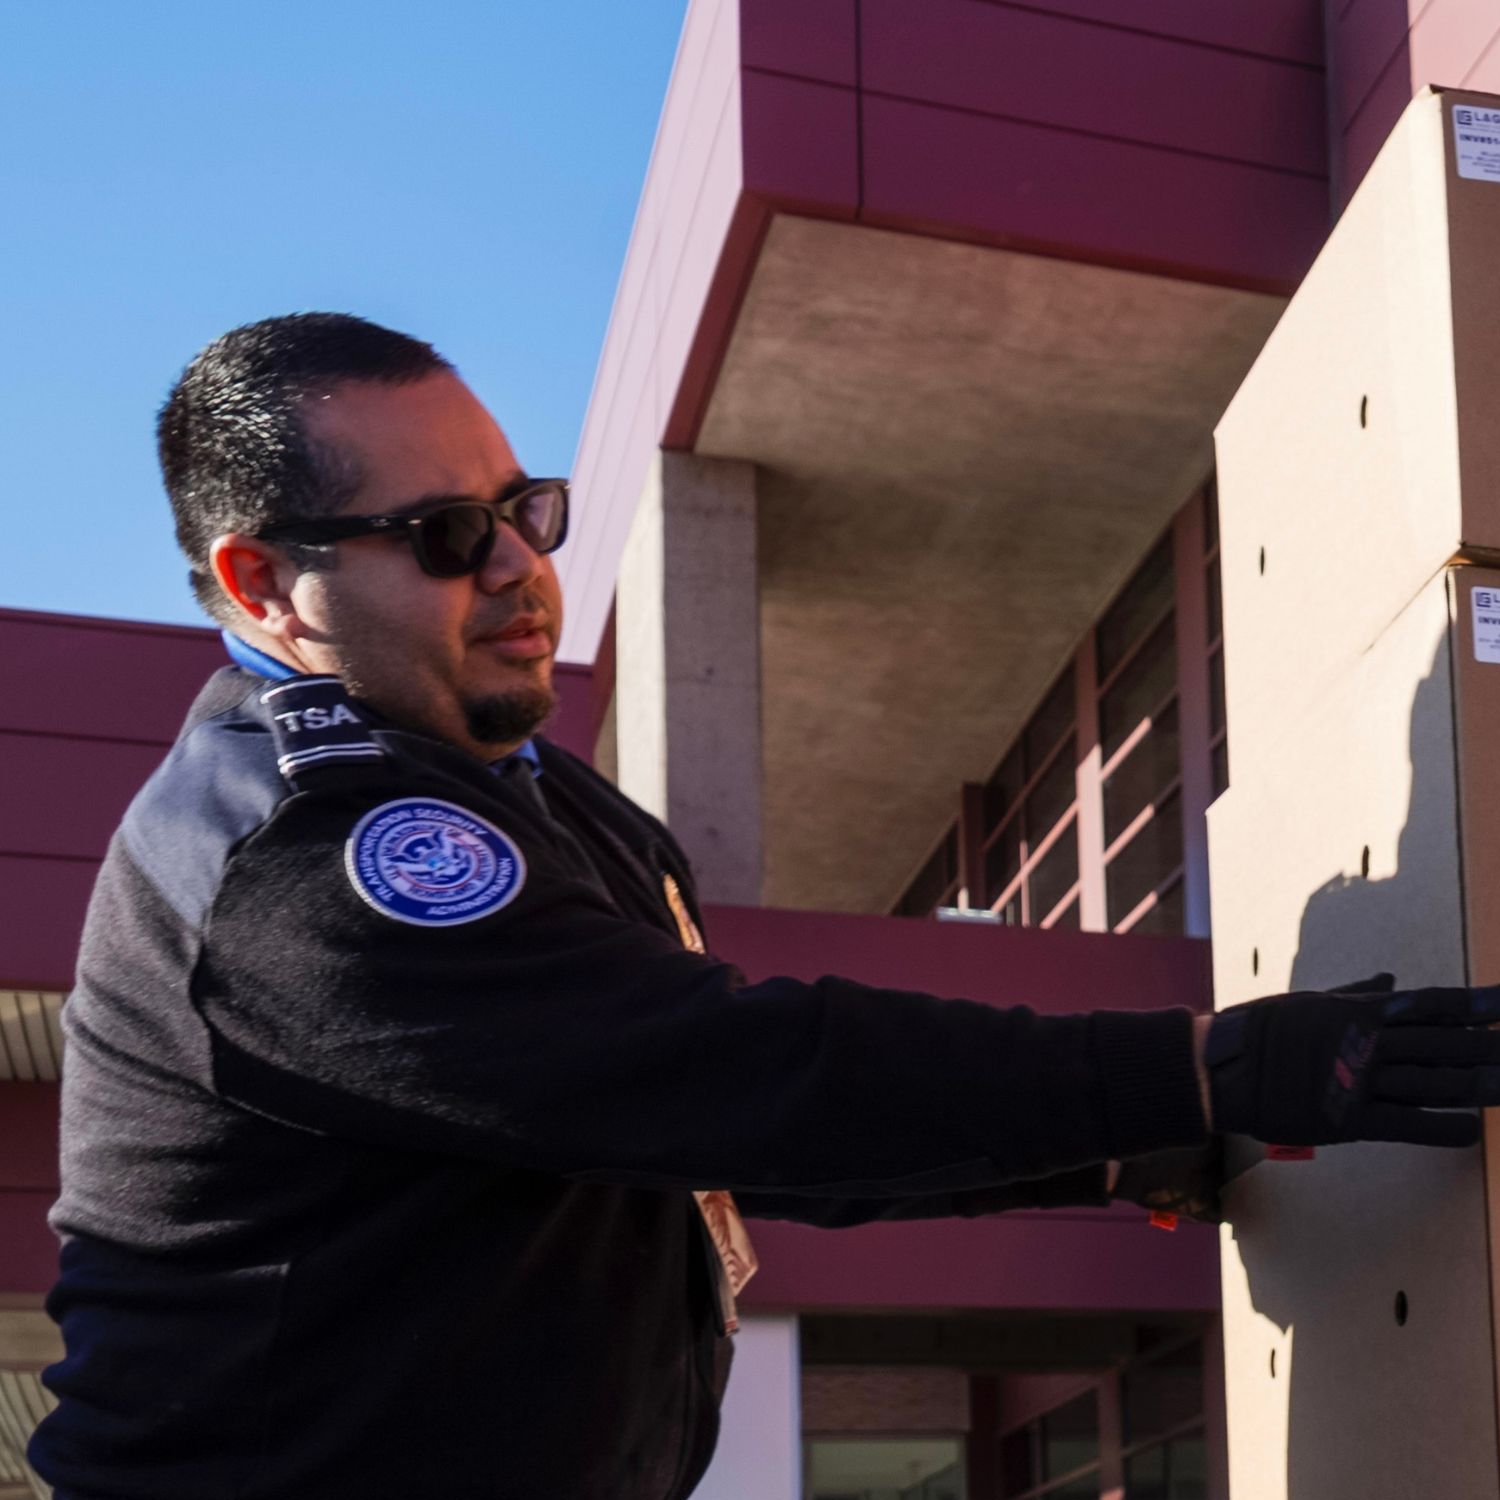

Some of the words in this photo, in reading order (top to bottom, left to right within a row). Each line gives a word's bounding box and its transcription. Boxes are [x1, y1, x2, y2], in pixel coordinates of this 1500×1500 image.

[274, 703, 362, 733] TSA
[359, 809, 413, 901] TRANSPORTATION
[413, 808, 488, 836] SECURITY
[426, 857, 513, 916] ADMINISTRATION
